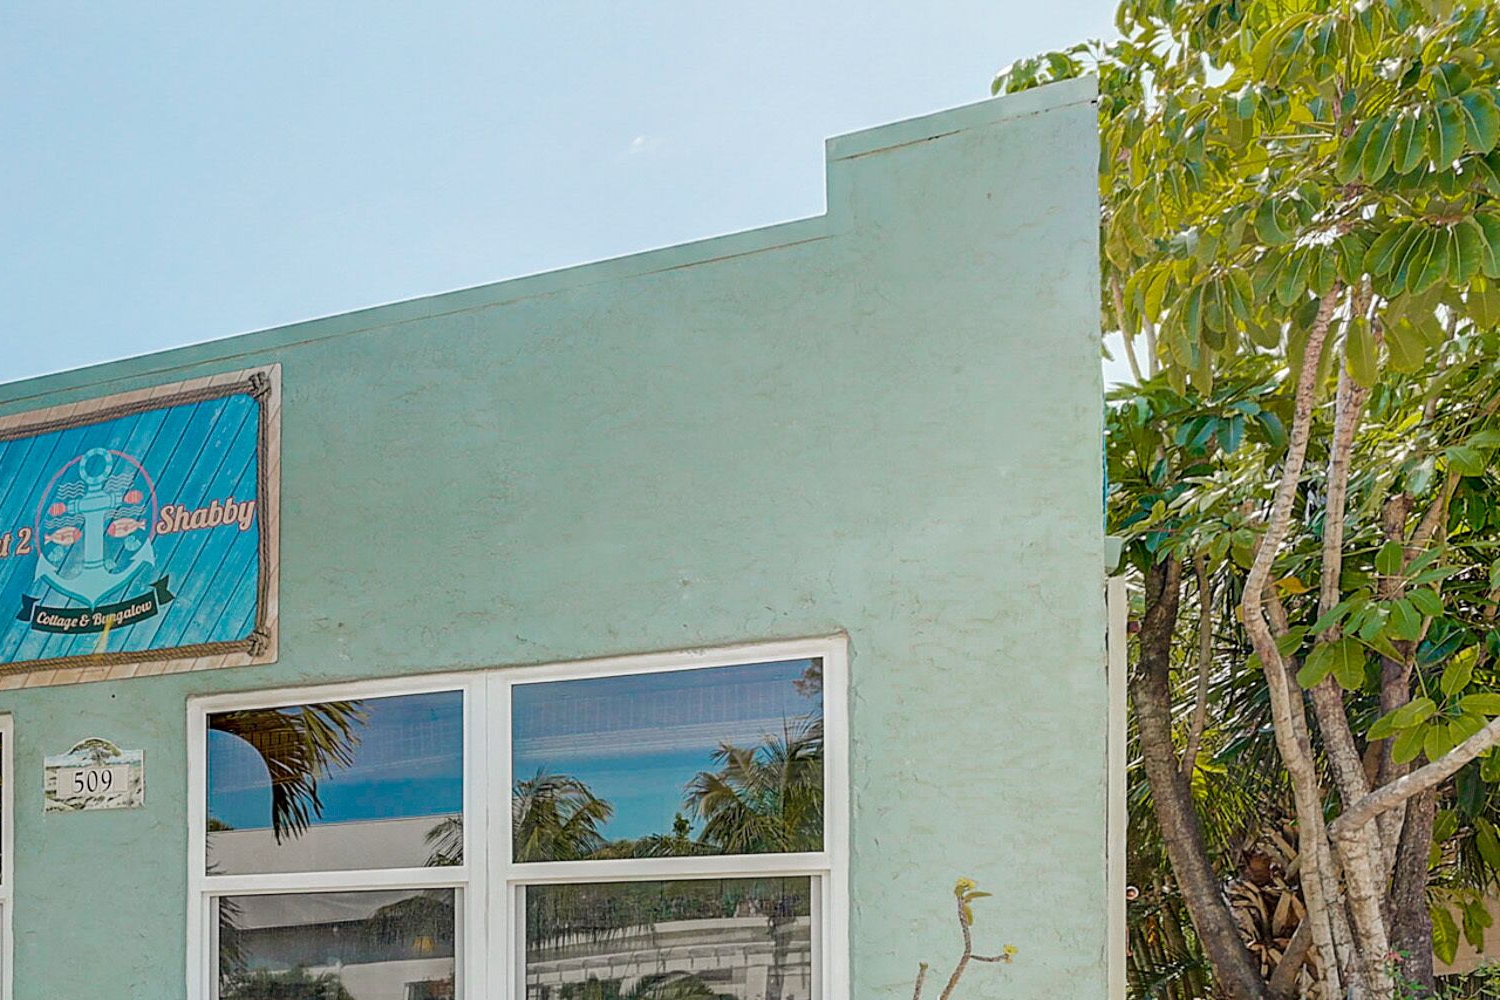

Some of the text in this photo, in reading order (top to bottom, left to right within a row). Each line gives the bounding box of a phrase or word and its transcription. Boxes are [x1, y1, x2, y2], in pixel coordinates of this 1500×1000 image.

[15, 526, 32, 556] 2
[156, 496, 256, 535] Shabby
[36, 600, 152, 631] Cottage & Bungalow
[73, 769, 113, 793] 509
